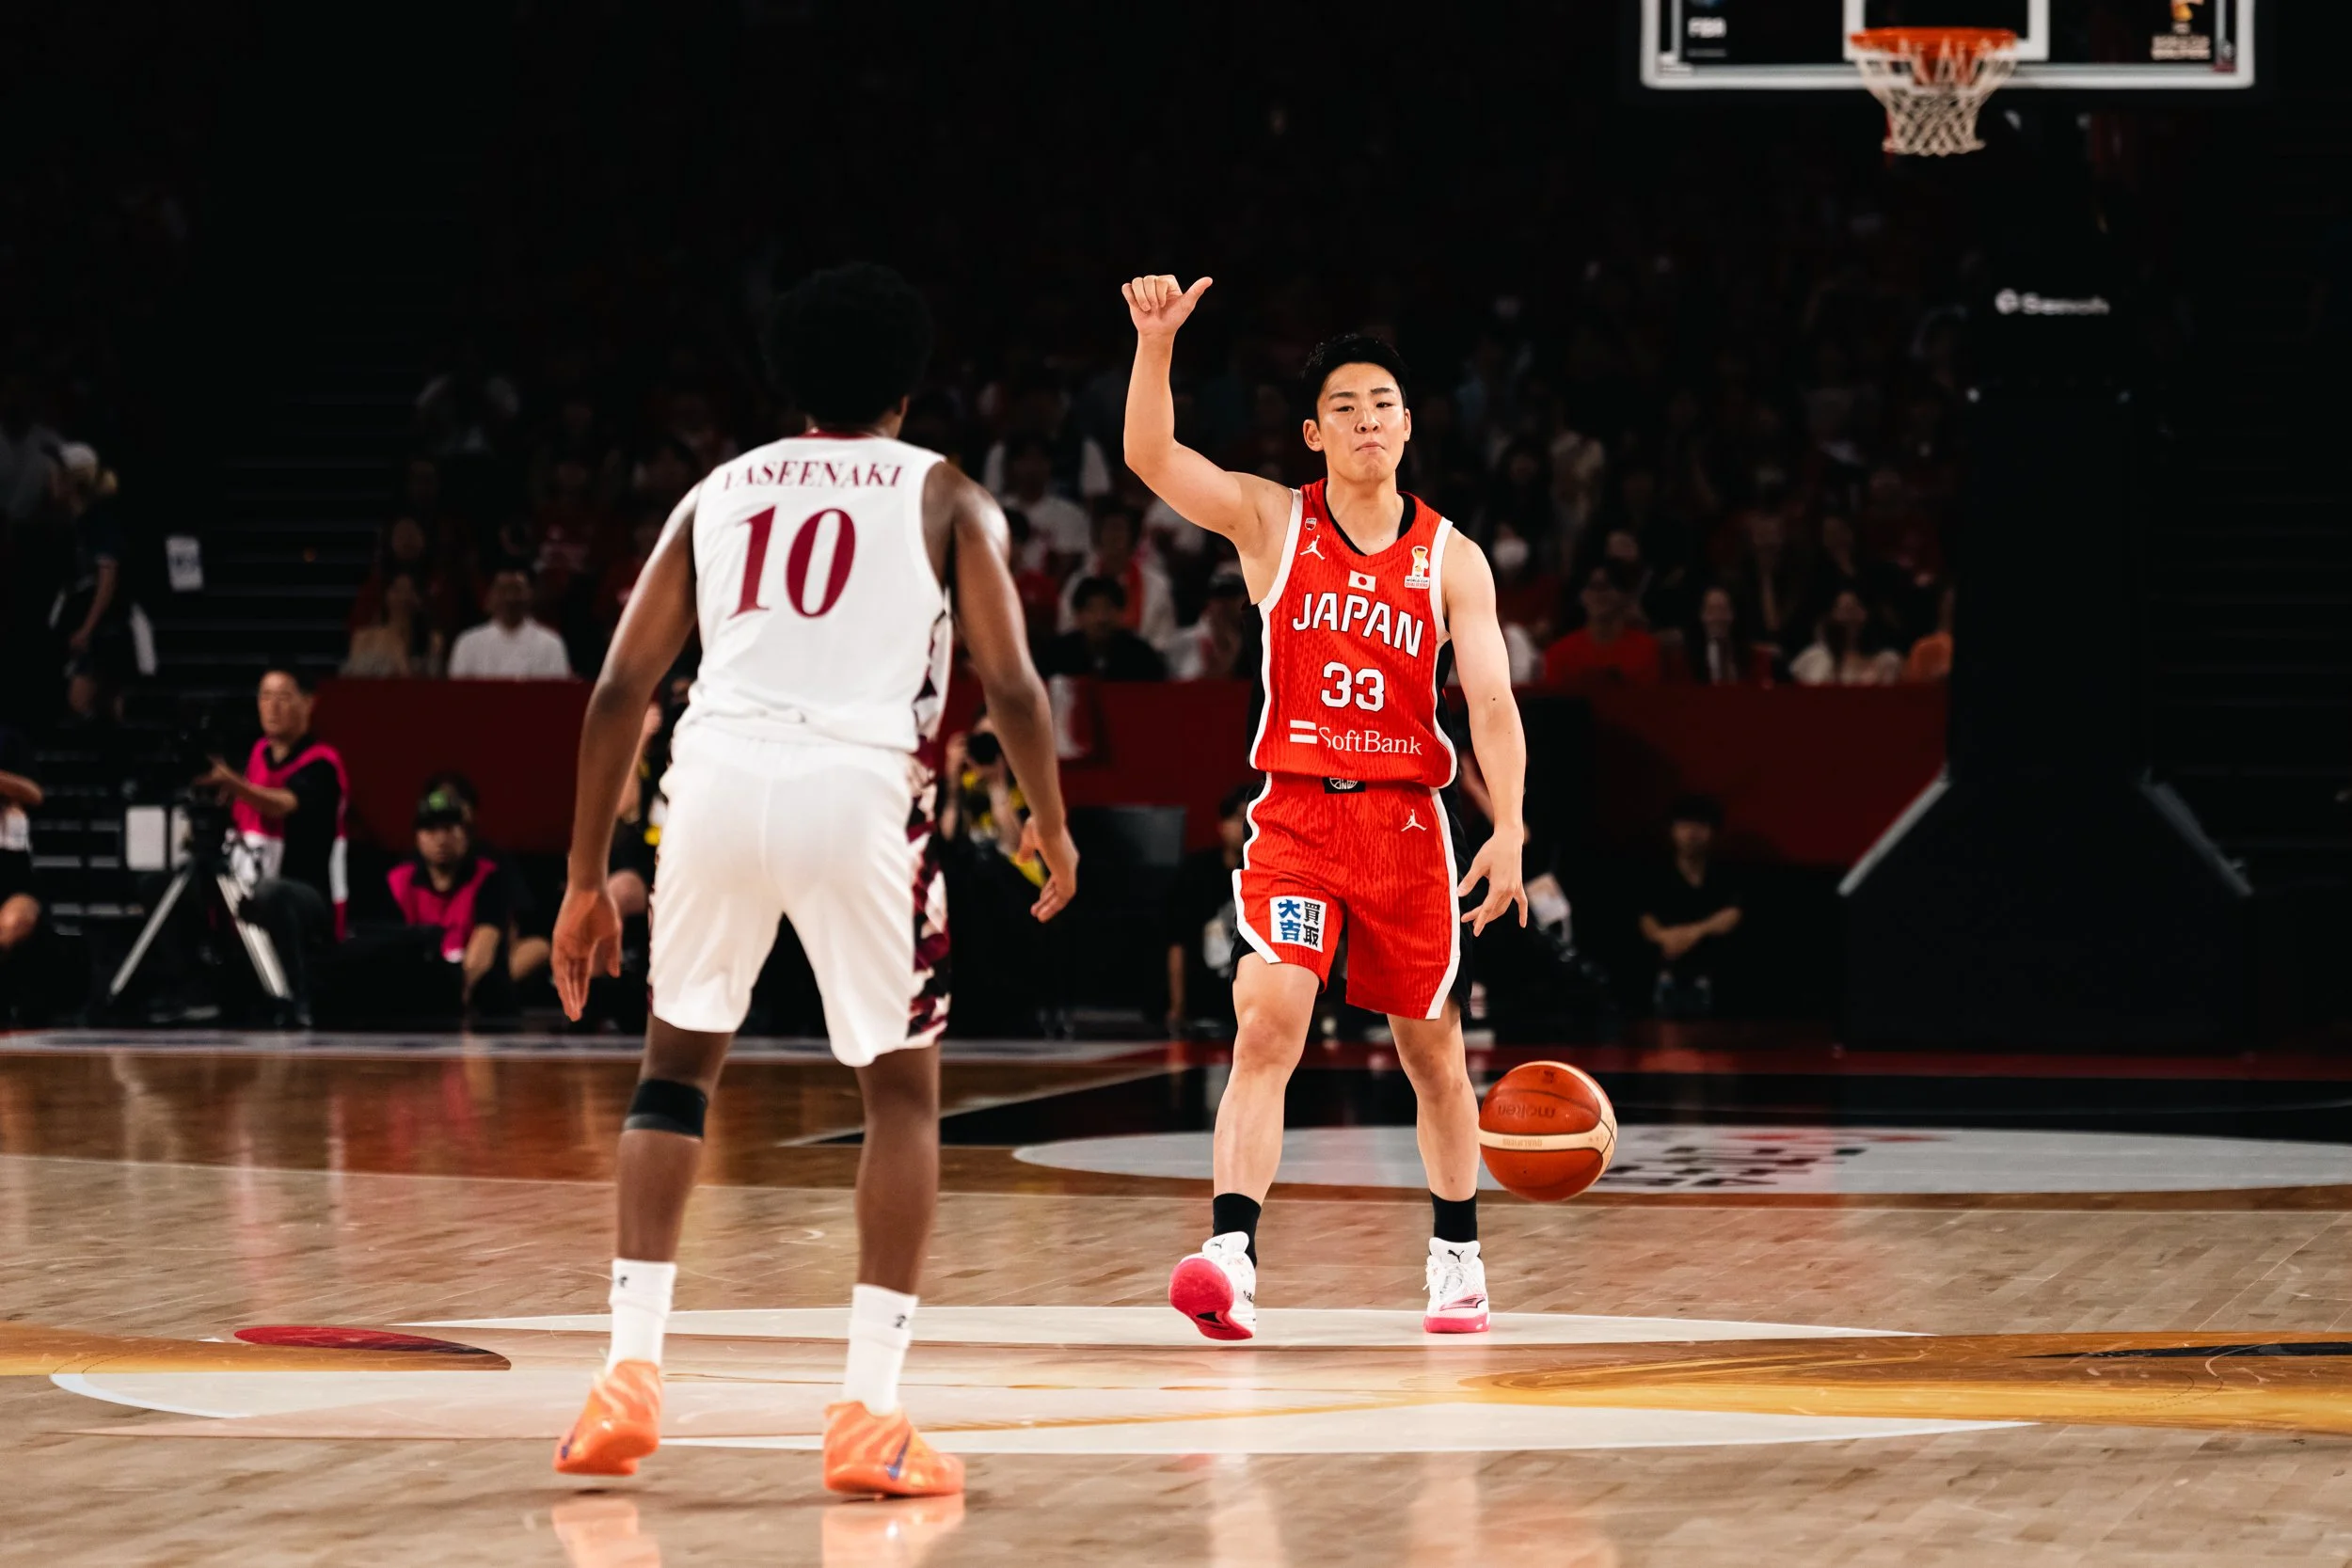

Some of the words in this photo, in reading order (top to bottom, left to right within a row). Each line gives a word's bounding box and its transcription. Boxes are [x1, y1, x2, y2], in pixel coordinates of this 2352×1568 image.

[727, 504, 856, 620] 10
[1292, 592, 1424, 658] JAPAN
[1321, 661, 1385, 712] 33
[1318, 726, 1422, 755] SoftBank
[1277, 898, 1301, 942] 大吉
[1303, 900, 1321, 947] 買取
